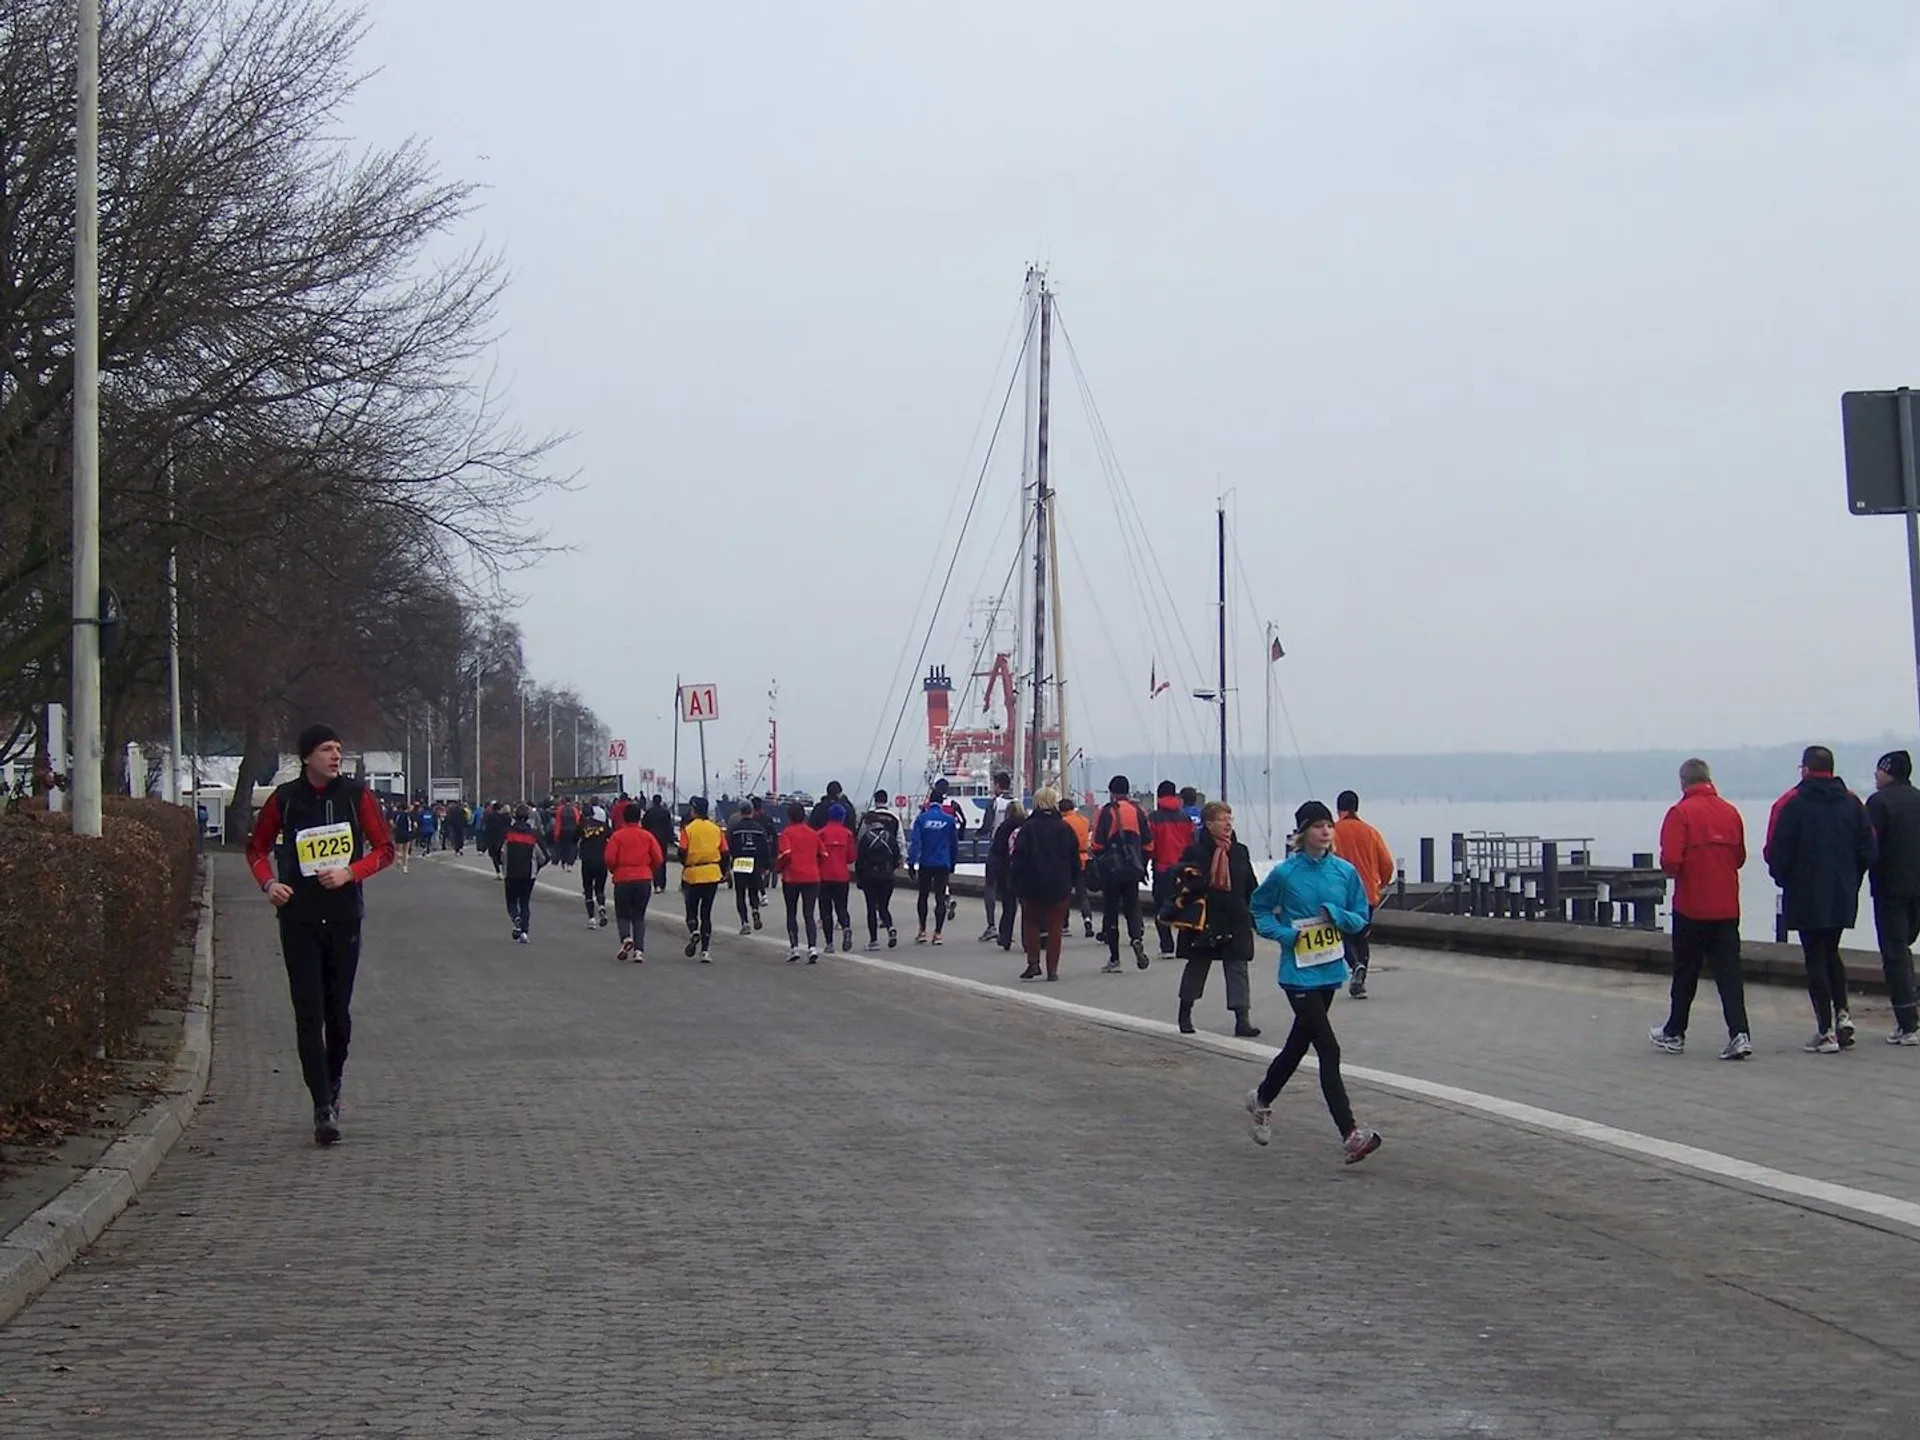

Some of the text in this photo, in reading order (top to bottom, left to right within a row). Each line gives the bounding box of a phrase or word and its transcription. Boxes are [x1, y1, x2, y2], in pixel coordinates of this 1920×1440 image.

[690, 689, 714, 715] A1
[608, 742, 626, 758] A2
[306, 836, 351, 859] 1225
